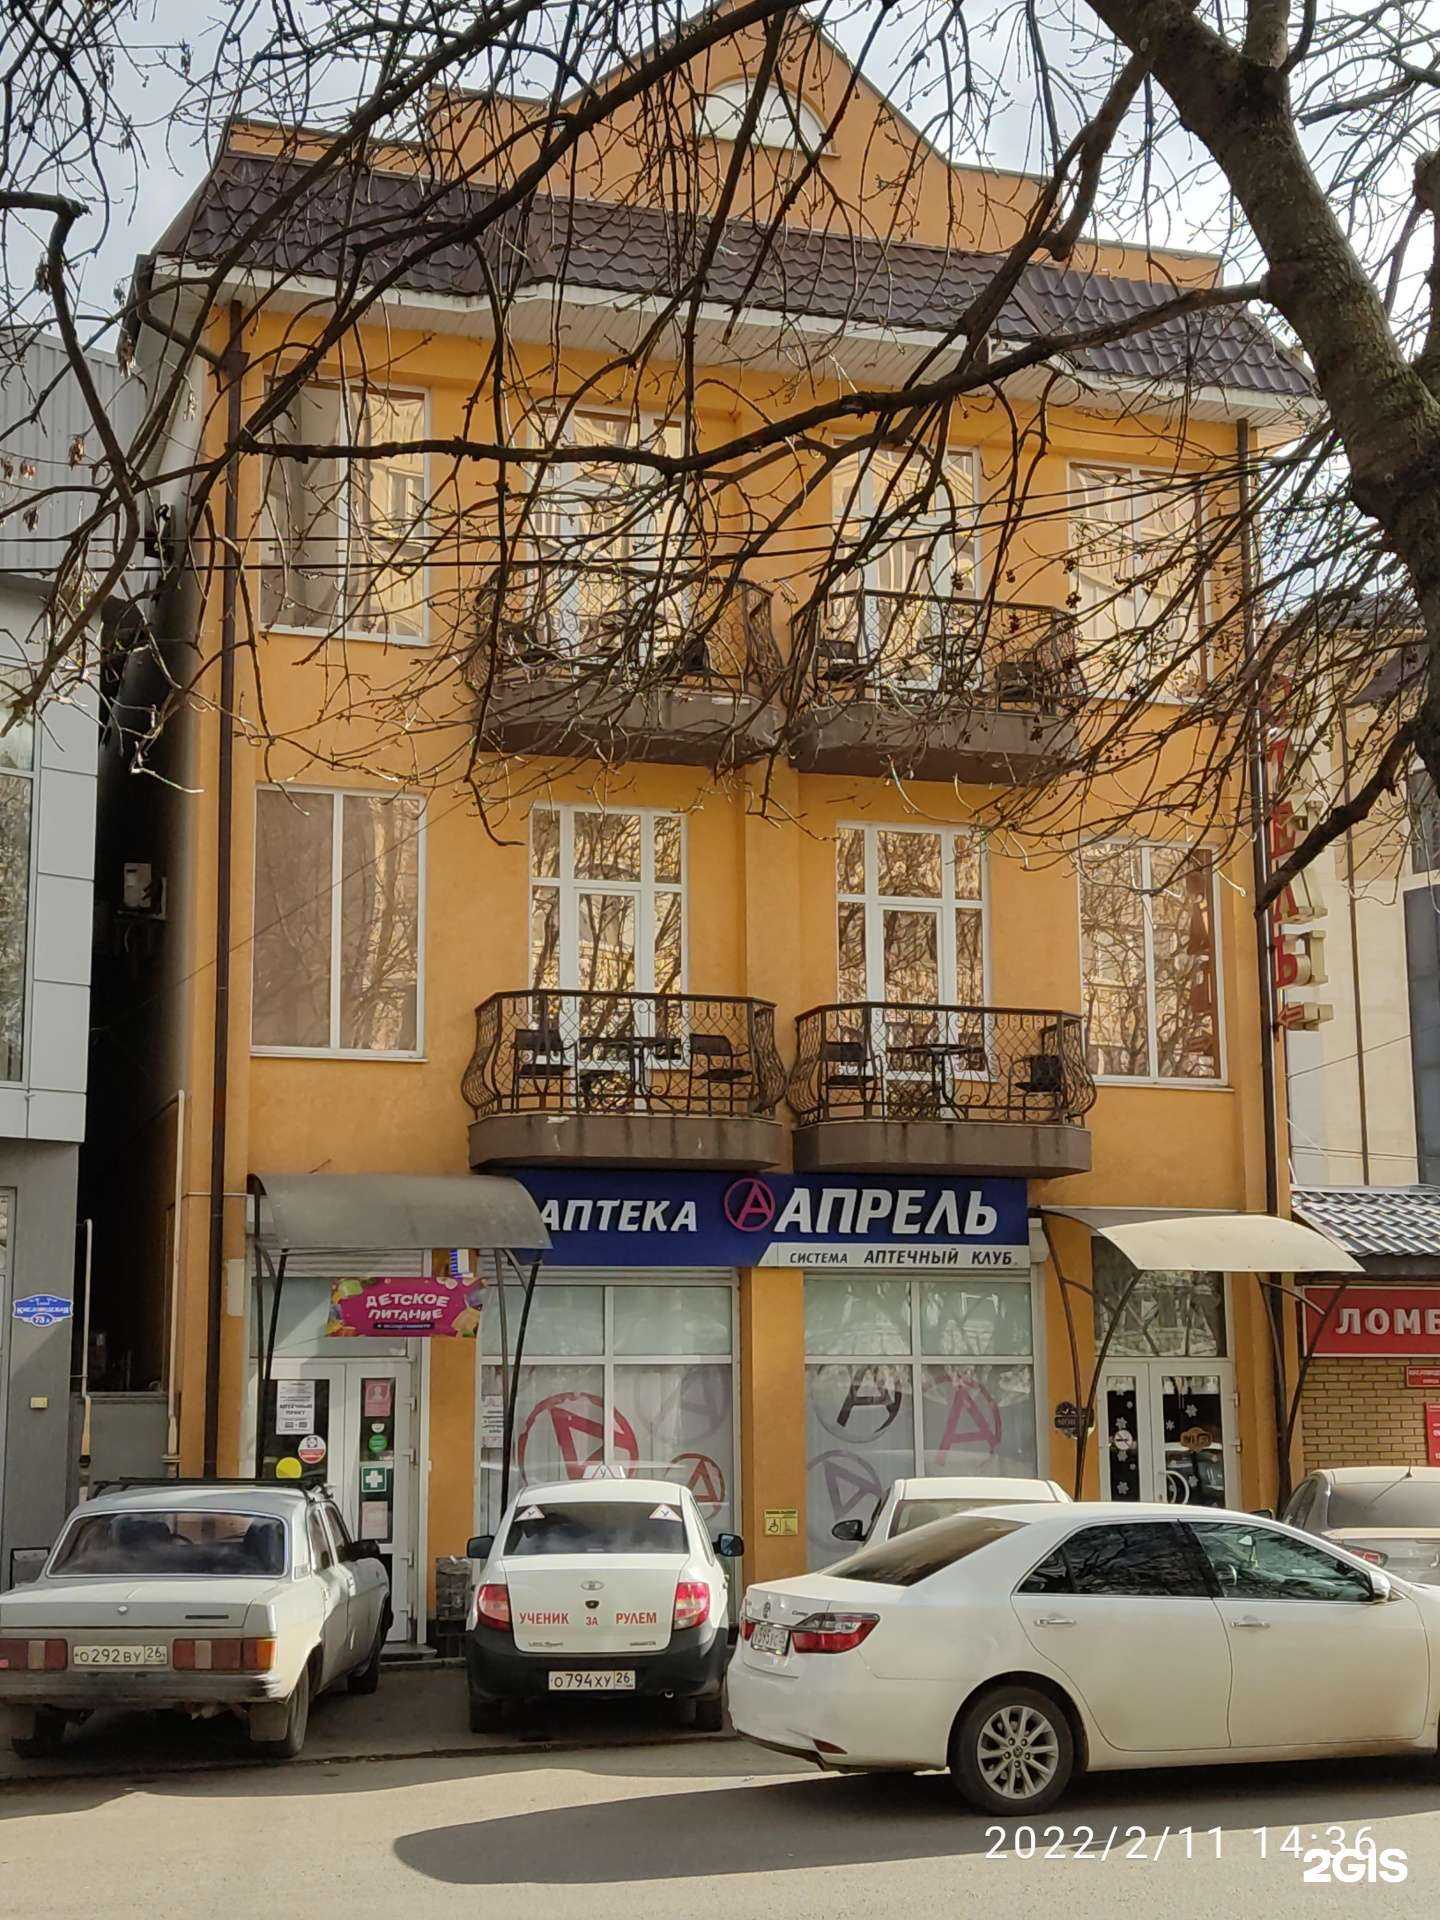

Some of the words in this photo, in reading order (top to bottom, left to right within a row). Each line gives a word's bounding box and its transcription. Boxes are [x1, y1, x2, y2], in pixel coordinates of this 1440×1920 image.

[540, 1200, 698, 1232] АПТЕКА
[774, 1188, 998, 1236] АПРЕЛЬ
[789, 1252, 849, 1264] СИСТЕМА
[863, 1247, 959, 1265] АПТЕЧНЫЙ
[971, 1251, 1013, 1265] КЛУБ
[366, 1293, 450, 1309] ДЕТСКОЕ
[368, 1308, 443, 1320] ПИТАНИЕ
[519, 1612, 570, 1625] УЧЕНИК
[585, 1616, 599, 1626] ЗА
[615, 1612, 657, 1625] РУЛЕМ
